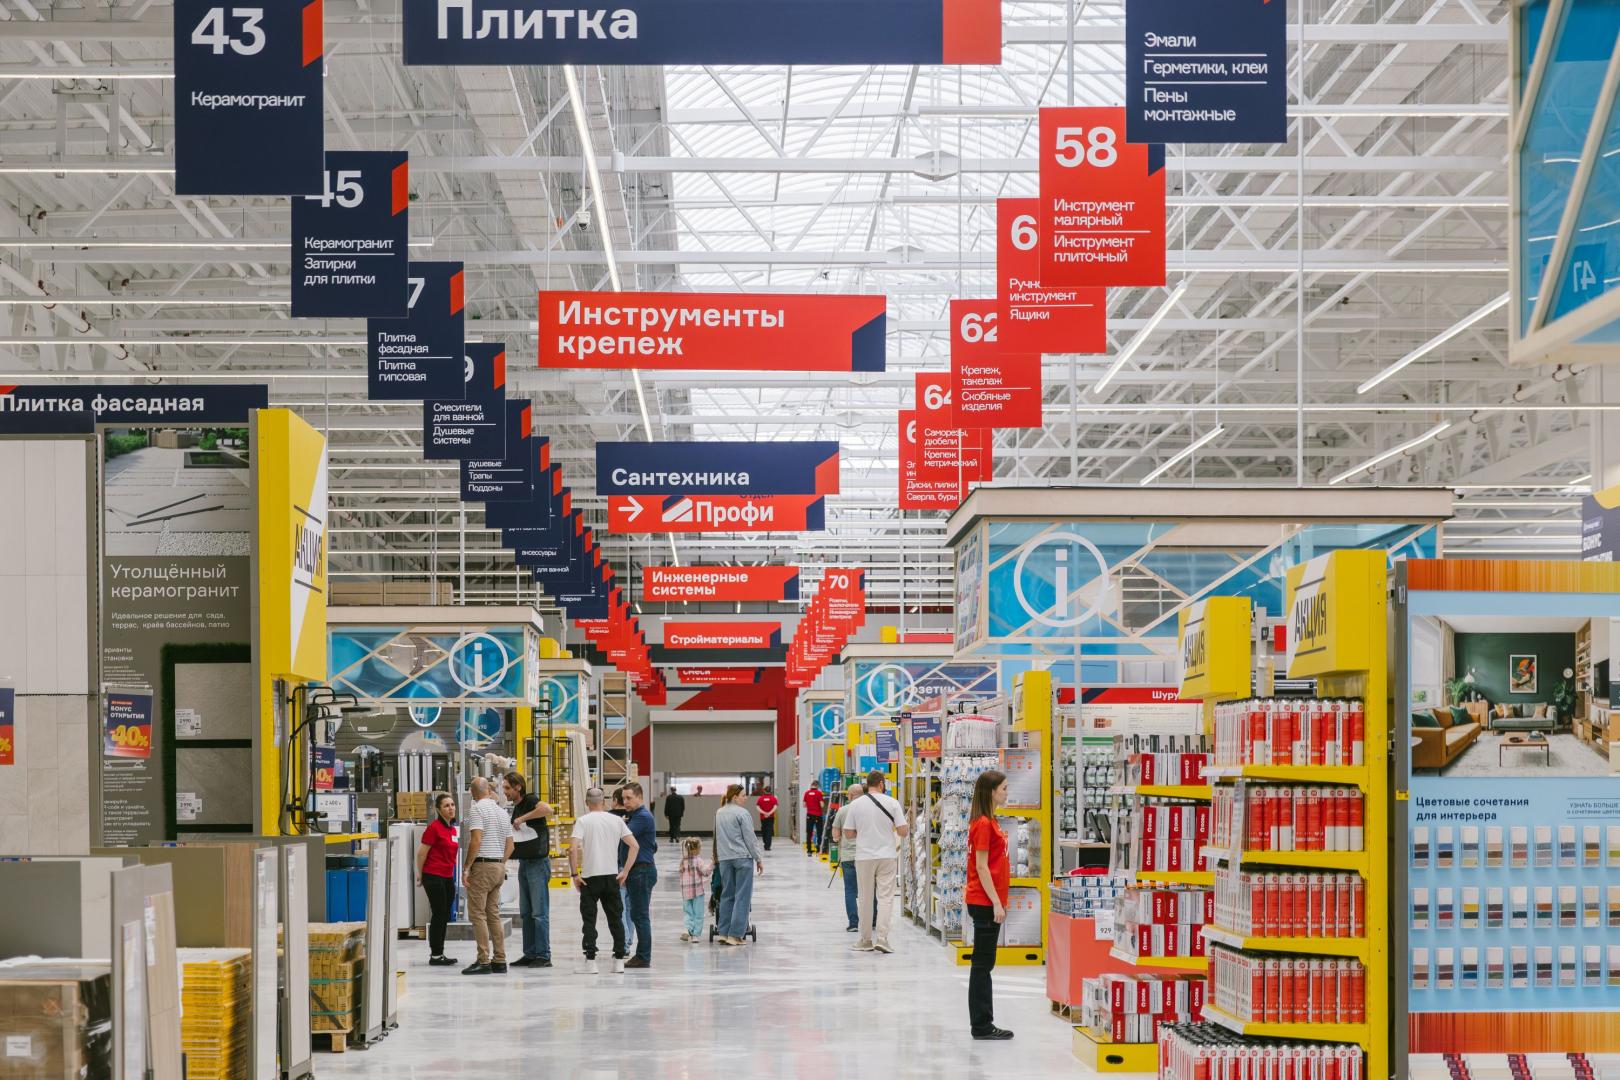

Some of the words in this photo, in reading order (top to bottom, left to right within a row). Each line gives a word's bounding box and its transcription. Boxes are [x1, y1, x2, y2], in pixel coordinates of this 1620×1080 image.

[437, 0, 638, 40] Плитка
[191, 7, 266, 55] 43
[1144, 32, 1197, 48] Эмали
[1144, 60, 1228, 77] Герметики,
[1232, 62, 1268, 74] клеи
[191, 92, 305, 109] Керамогранит
[1144, 87, 1188, 103] Пены
[1144, 109, 1236, 121] монтажные
[1055, 126, 1118, 168] 58
[1054, 199, 1135, 213] Инструмент
[1054, 213, 1123, 228] малярный
[1010, 215, 1039, 250] 6
[305, 236, 394, 251] Керамогранит
[1054, 235, 1135, 249] Инструмент
[1054, 250, 1128, 263] плиточный
[305, 257, 356, 271] Затирки
[304, 273, 328, 287] для
[331, 273, 376, 285] плитки
[408, 278, 425, 309] 7
[1010, 291, 1077, 304] инструмент
[558, 300, 784, 331] Инструменты
[1010, 309, 1050, 321] Ящики
[961, 313, 997, 342] 62
[378, 332, 416, 343] Плитка
[378, 343, 429, 355] фасадная
[558, 335, 683, 360] крепеж
[378, 360, 416, 370] Плитка
[961, 365, 1001, 377] Крепеж,
[378, 372, 427, 383] гипсовая
[961, 377, 1003, 386] такелаж
[961, 391, 1011, 402] Скобяные
[0, 393, 84, 412] Плитка
[91, 394, 205, 416] фасадная
[433, 402, 482, 412] Смесители
[961, 402, 1003, 412] изделия
[433, 412, 450, 422] для
[452, 412, 485, 422] ванной
[433, 427, 475, 438] Душевые
[433, 436, 471, 445] системы
[924, 437, 958, 446] дюбели
[924, 450, 957, 460] Крепеж
[468, 472, 493, 481] Трапы
[611, 468, 750, 486] Сантехника
[468, 484, 503, 493] Поддоны
[907, 481, 933, 490] Диски,
[906, 493, 936, 502] Сверла,
[938, 493, 958, 502] буры
[696, 501, 774, 527] Профи
[295, 523, 322, 584] АКЦИЯ
[111, 563, 227, 580] Утолщённый
[652, 571, 749, 585] Инженерные
[829, 575, 849, 589] 70
[111, 584, 240, 601] керамогранит
[652, 585, 716, 595] системы
[111, 612, 152, 620] Идеальное
[1294, 593, 1327, 647] АКЦИЯ
[670, 633, 763, 646] Стройматериалы
[1184, 630, 1205, 673] АКЦИЯ
[912, 685, 955, 695] озетки
[1152, 690, 1179, 700] Шуру
[110, 725, 148, 747] -40%
[1416, 796, 1470, 807] Цветовые
[1473, 798, 1529, 806] сочетания
[1416, 813, 1437, 822] для
[1440, 812, 1497, 822] интерьера
